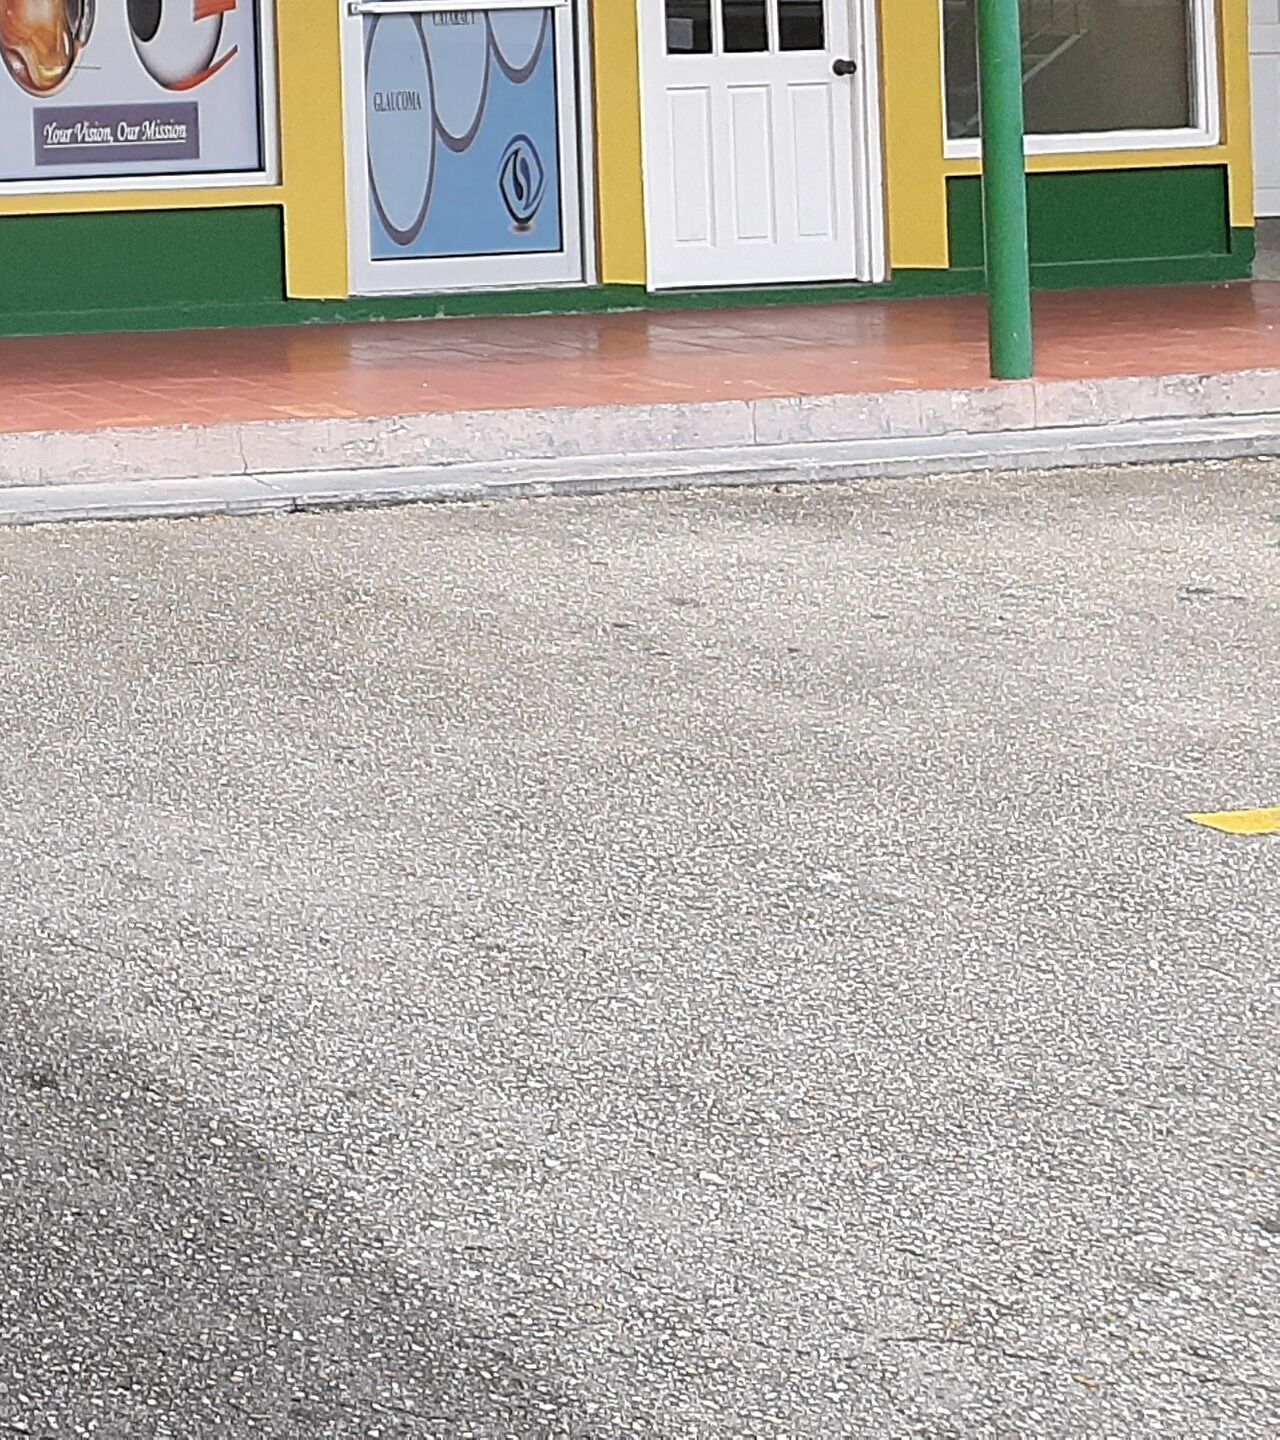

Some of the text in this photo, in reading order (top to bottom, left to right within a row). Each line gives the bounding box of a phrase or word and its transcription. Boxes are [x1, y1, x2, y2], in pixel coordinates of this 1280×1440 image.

[373, 91, 422, 112] GLAUCOMA
[43, 118, 187, 143] Your Vision, Our Mission
